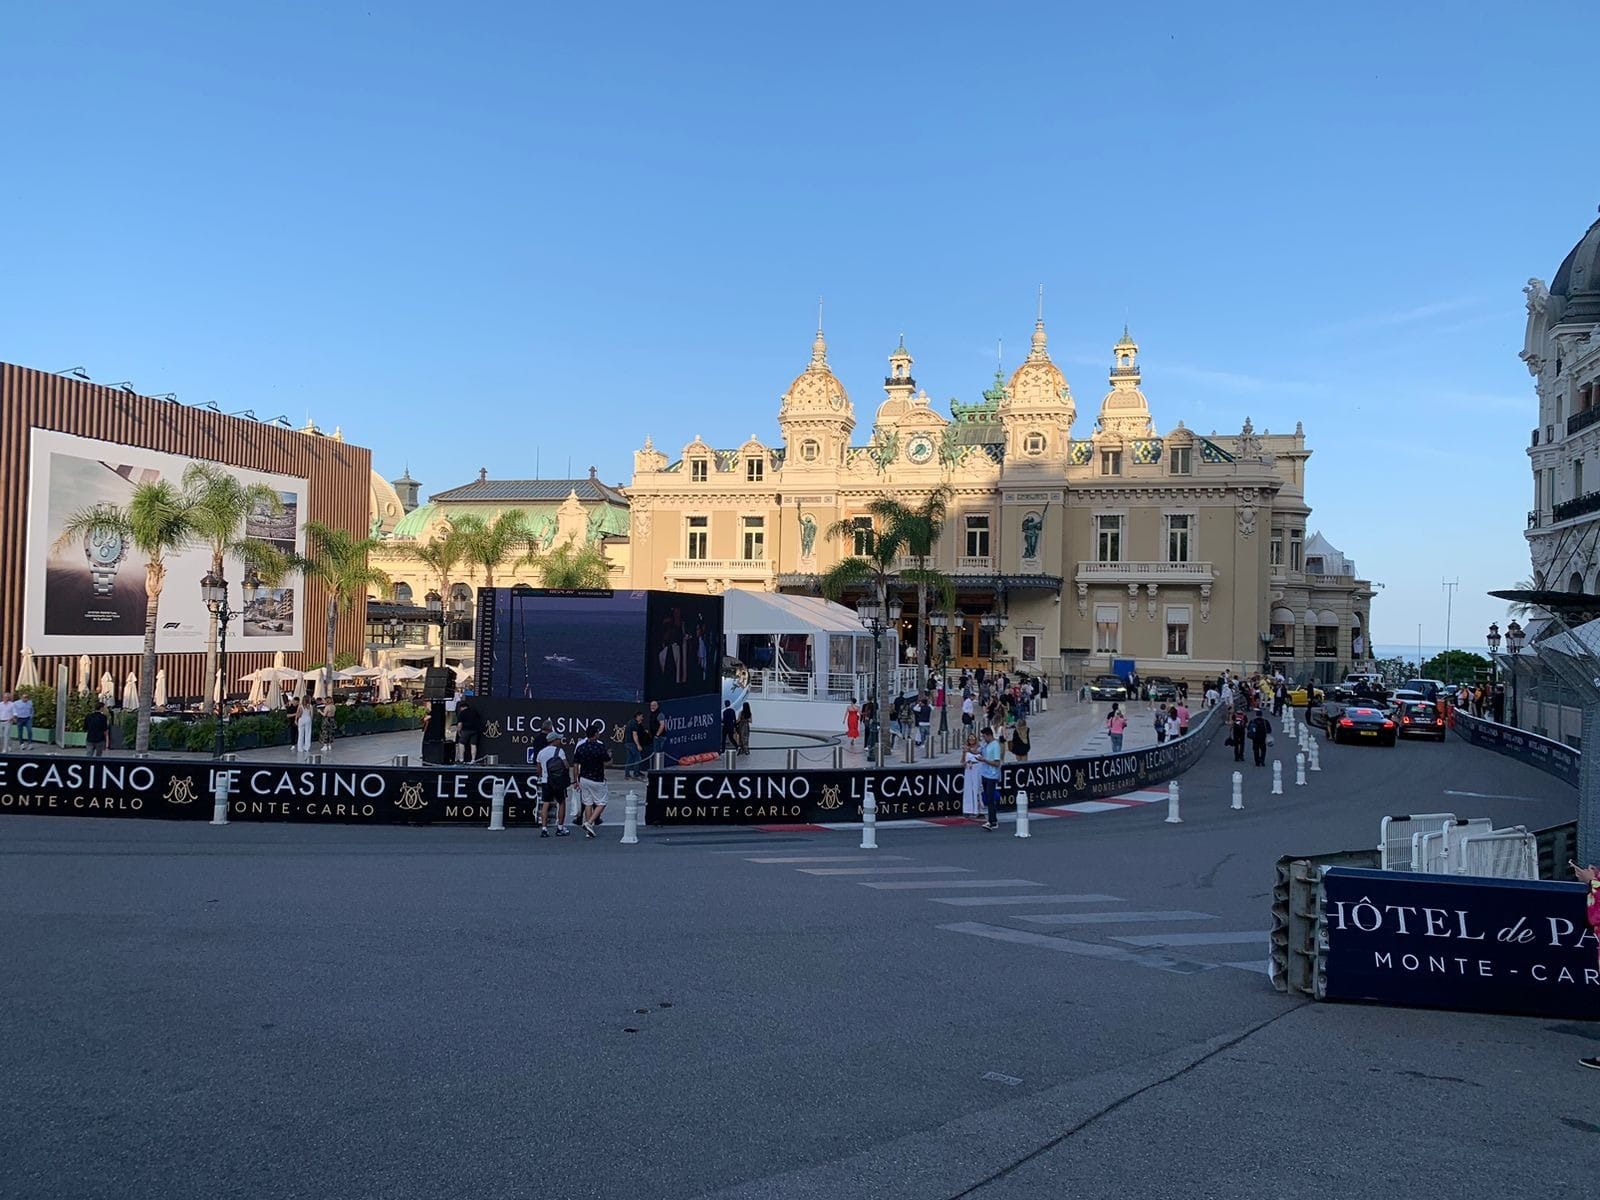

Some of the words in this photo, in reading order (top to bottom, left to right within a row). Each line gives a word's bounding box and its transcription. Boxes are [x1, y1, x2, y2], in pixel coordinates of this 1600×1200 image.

[506, 716, 526, 731] LE
[693, 713, 714, 728] PARIS
[17, 762, 155, 791] CASINO
[1015, 764, 1071, 788] CASINO
[1088, 761, 1100, 779] LE
[1102, 756, 1138, 778] CASINO
[208, 769, 241, 793] LE
[250, 770, 386, 798] CASINO
[437, 774, 469, 798] LE
[657, 776, 688, 800] LE
[695, 776, 810, 800] CASINO
[851, 777, 875, 798] LE
[880, 773, 965, 798] CASINO
[1496, 916, 1537, 945] de
